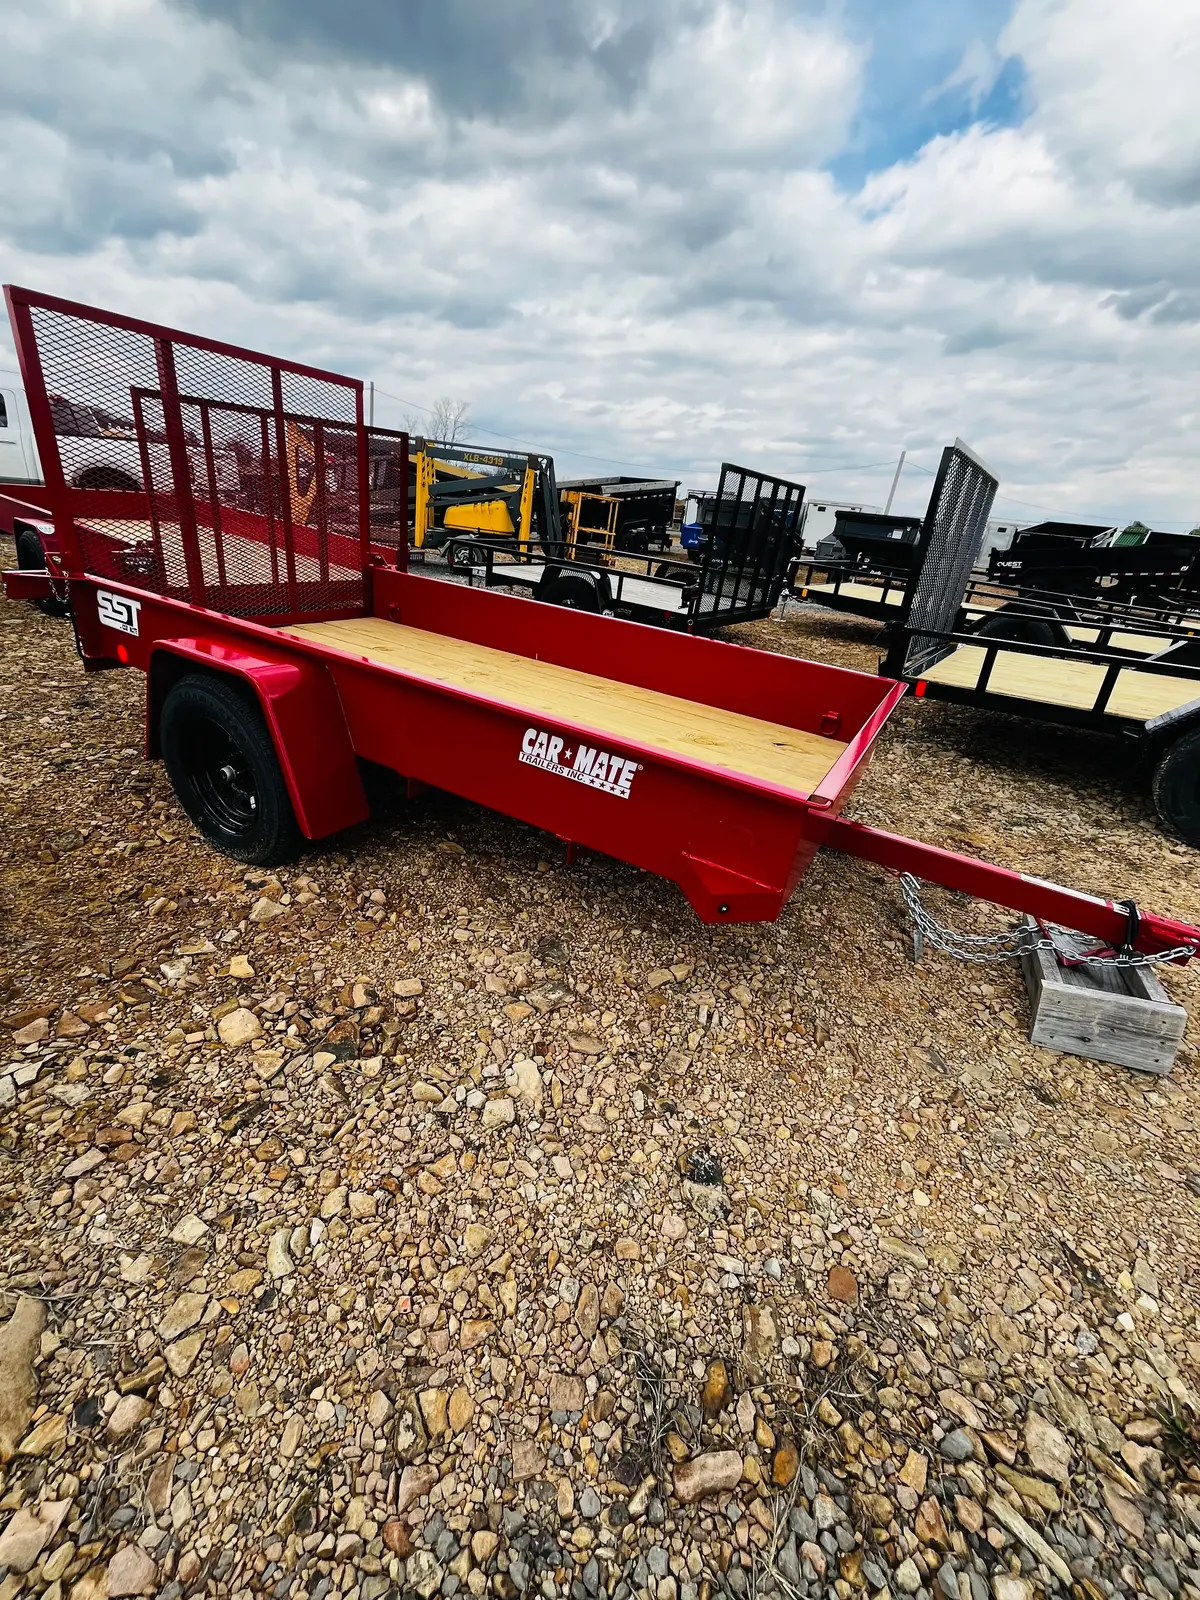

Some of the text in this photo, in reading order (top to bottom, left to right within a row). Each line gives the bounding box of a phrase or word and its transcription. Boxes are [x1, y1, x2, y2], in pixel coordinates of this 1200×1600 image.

[463, 452, 504, 466] XLB-4319
[97, 589, 141, 637] SST
[519, 752, 586, 783] TRAILERS INC.
[522, 728, 638, 789] CAR MATE
